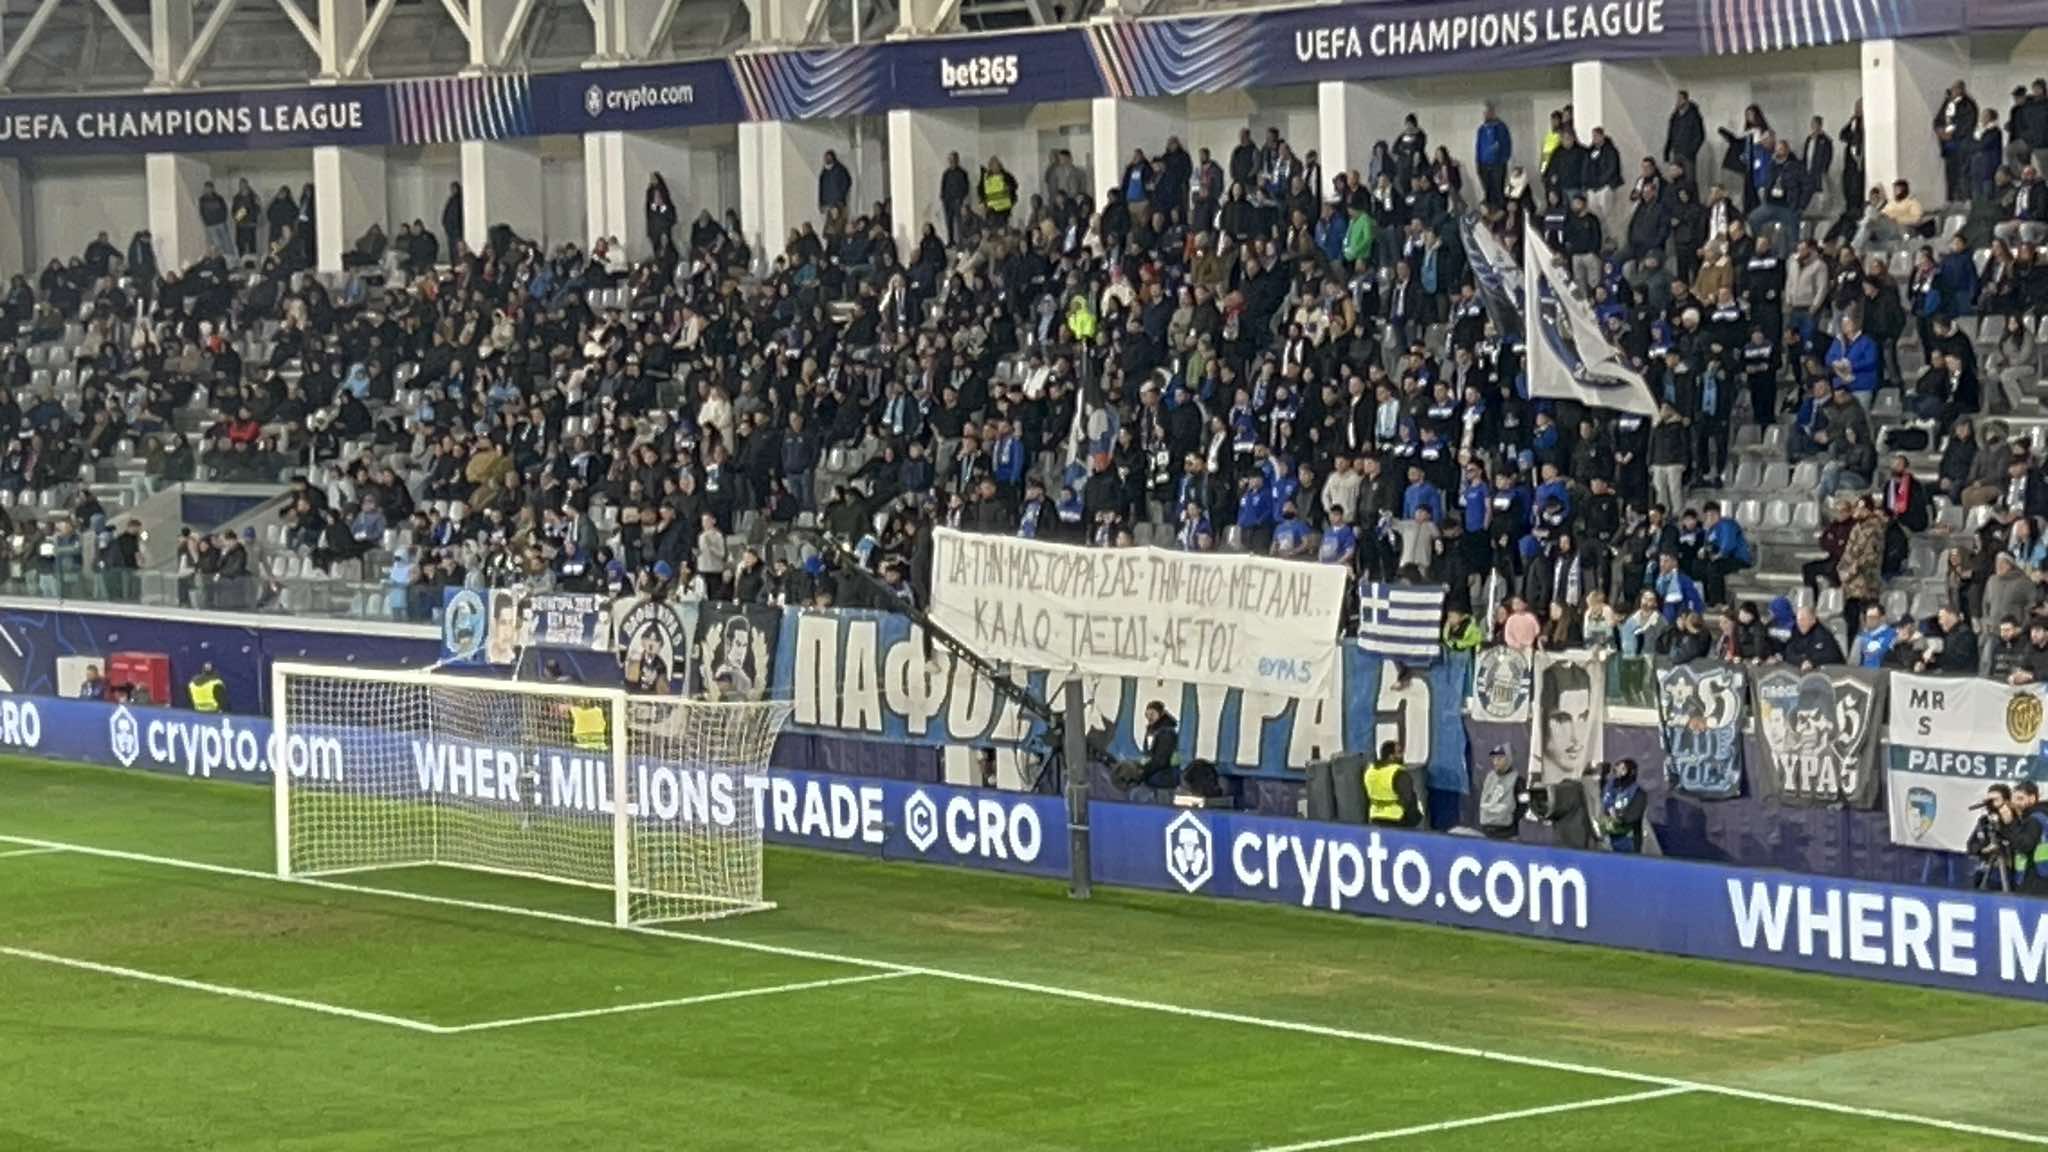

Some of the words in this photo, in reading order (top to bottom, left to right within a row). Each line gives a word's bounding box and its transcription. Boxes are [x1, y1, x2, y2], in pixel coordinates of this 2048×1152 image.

[1296, 25, 1362, 62] UEFA
[1370, 10, 1537, 56] CHAMPIONS
[1546, 0, 1664, 41] LEAGUE
[941, 54, 1018, 88] bet365
[606, 84, 693, 111] crypto.com
[0, 114, 69, 140] UEFA
[76, 107, 252, 138] CHAMPIONS
[259, 102, 363, 131] LEAGUE
[974, 597, 1050, 651] ΚΑΛΟ
[1909, 688, 1945, 711] MR
[0, 700, 41, 748] RO
[1917, 716, 1932, 736] S
[1908, 749, 1987, 777] PAFOS
[1994, 755, 2029, 779] F.C
[744, 775, 885, 843] TRADE
[946, 796, 1042, 863] CRO
[1232, 830, 1588, 928] crypto.com
[1727, 878, 1978, 976] WHERE
